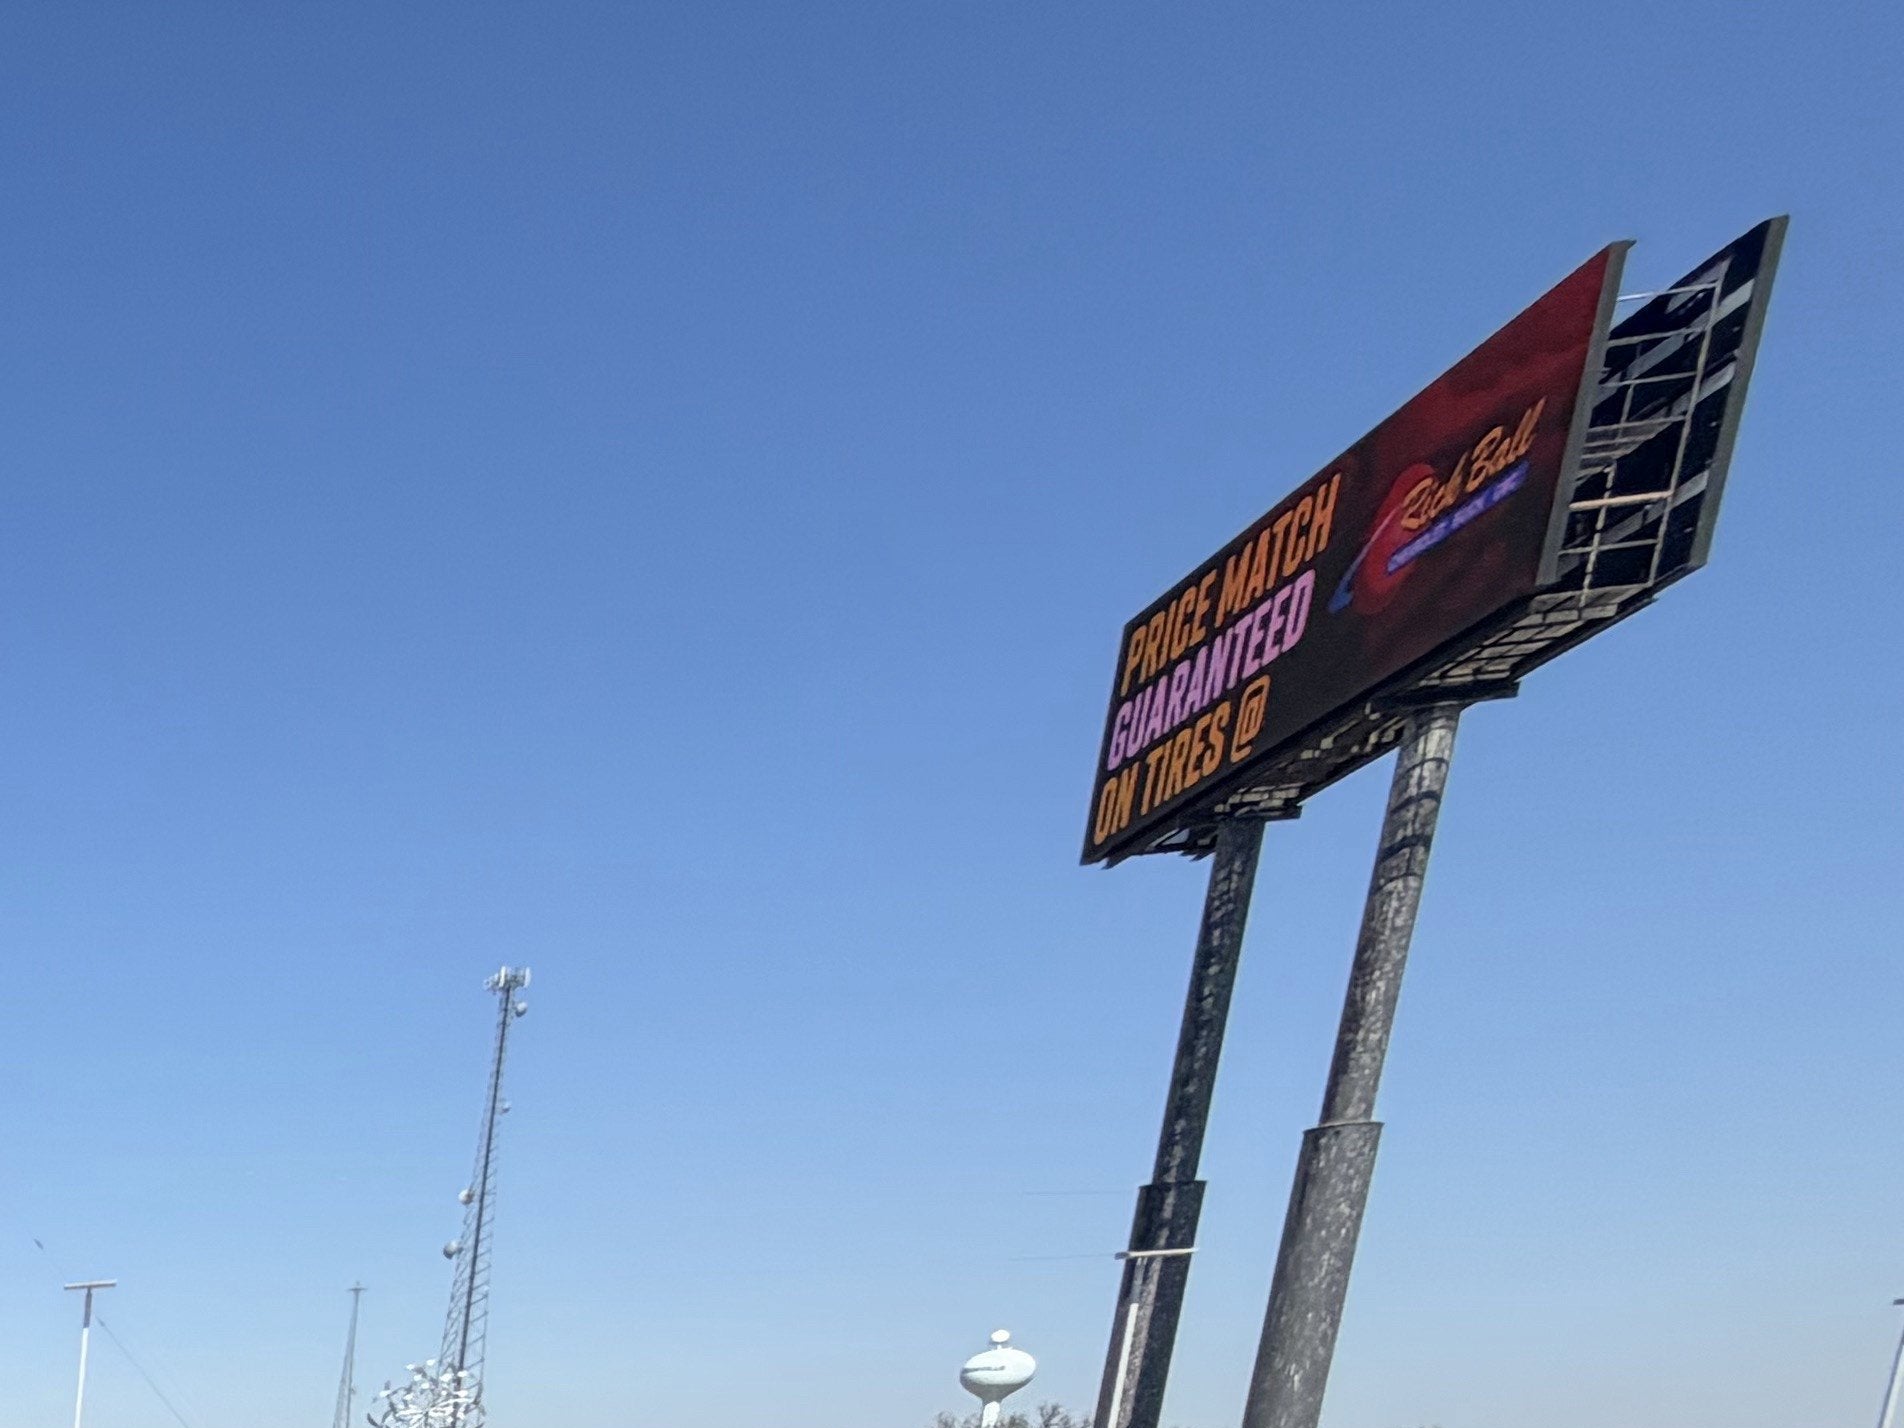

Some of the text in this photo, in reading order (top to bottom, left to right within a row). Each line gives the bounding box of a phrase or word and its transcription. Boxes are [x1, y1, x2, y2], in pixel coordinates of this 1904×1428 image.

[1465, 395, 1547, 494] Ball
[1106, 568, 1317, 773] GUARANTEED
[1120, 568, 1219, 698] PRICE
[1214, 471, 1342, 629] MATCH
[1093, 761, 1140, 846] ON
[1140, 700, 1233, 816] TIRES
